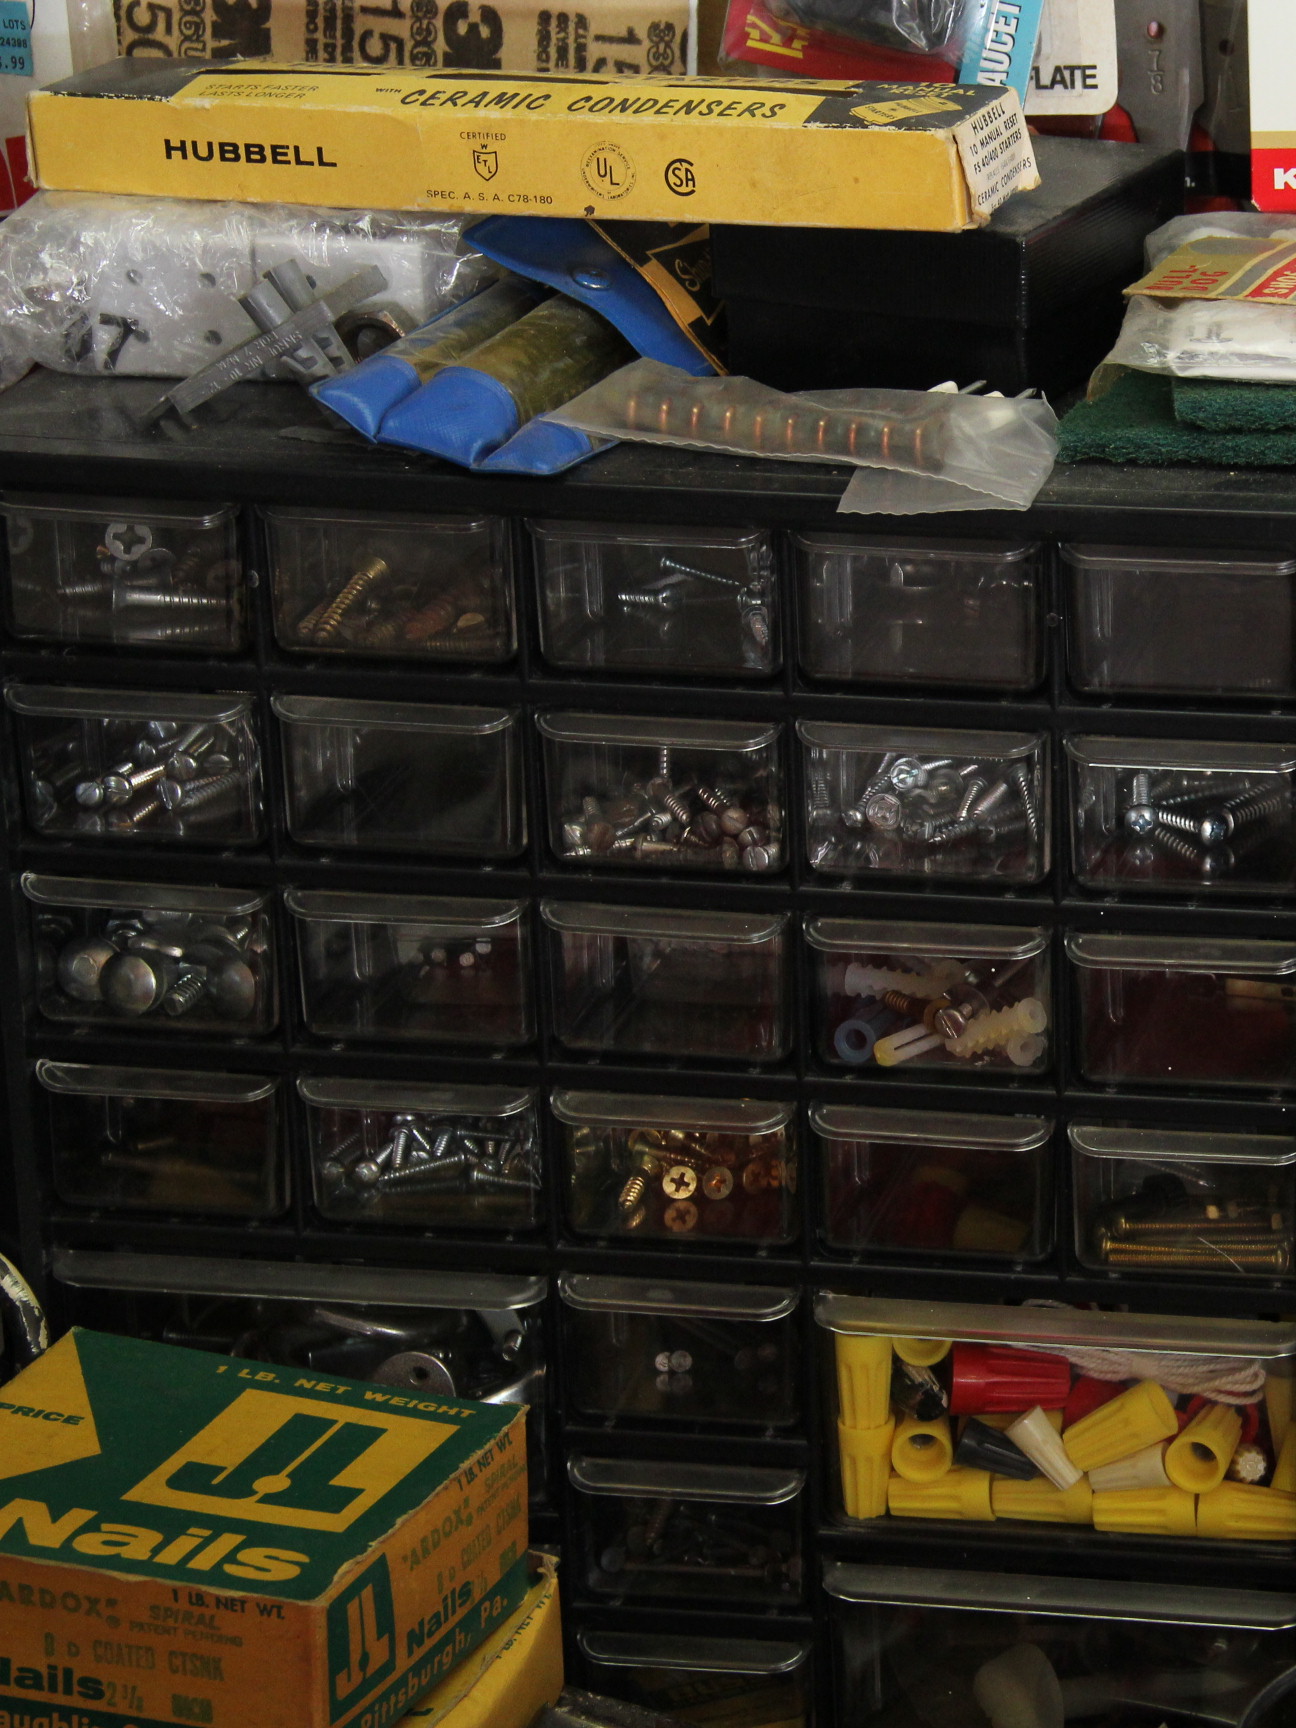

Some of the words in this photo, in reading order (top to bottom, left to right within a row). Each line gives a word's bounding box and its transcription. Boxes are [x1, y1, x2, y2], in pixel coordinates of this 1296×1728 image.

[3, 19, 26, 31] LOTS
[260, 84, 320, 92] FASTER
[1030, 65, 1099, 90] LATE
[400, 89, 552, 110] CERAMIC
[567, 95, 787, 119] CONDENSERS
[864, 105, 901, 120] STARTERS
[971, 102, 1006, 135] HUBBELL
[459, 131, 507, 141] CERTIFIED
[969, 144, 978, 157] 10
[979, 127, 1003, 151] MANUAL
[1004, 113, 1019, 131] RESET
[164, 138, 338, 168] HUBBELL
[973, 161, 982, 175] FS
[999, 128, 1022, 154] STARTERS
[596, 157, 620, 186] UL
[977, 181, 999, 206] CERAMIC
[1001, 157, 1032, 187] CONDENSERS
[426, 189, 458, 200] SPEC.
[464, 192, 475, 201] A.
[478, 192, 490, 201] S.
[493, 193, 504, 202] A.
[507, 193, 554, 205] C78-180
[215, 1365, 228, 1374] 1
[238, 1368, 280, 1383] LB.
[294, 1378, 353, 1395] NET
[363, 1390, 477, 1418] WEIGHT
[0, 1402, 85, 1425] PRICE
[477, 1450, 495, 1472] NET
[0, 1497, 311, 1582] Nails
[171, 1589, 179, 1603] 1
[188, 1591, 209, 1608] LB.
[215, 1596, 248, 1613] NET
[149, 1605, 221, 1631] SPIRAL
[407, 1580, 475, 1658] Nails
[360, 1629, 472, 1728] Pittsburgh,
[480, 1594, 508, 1630] Pa.
